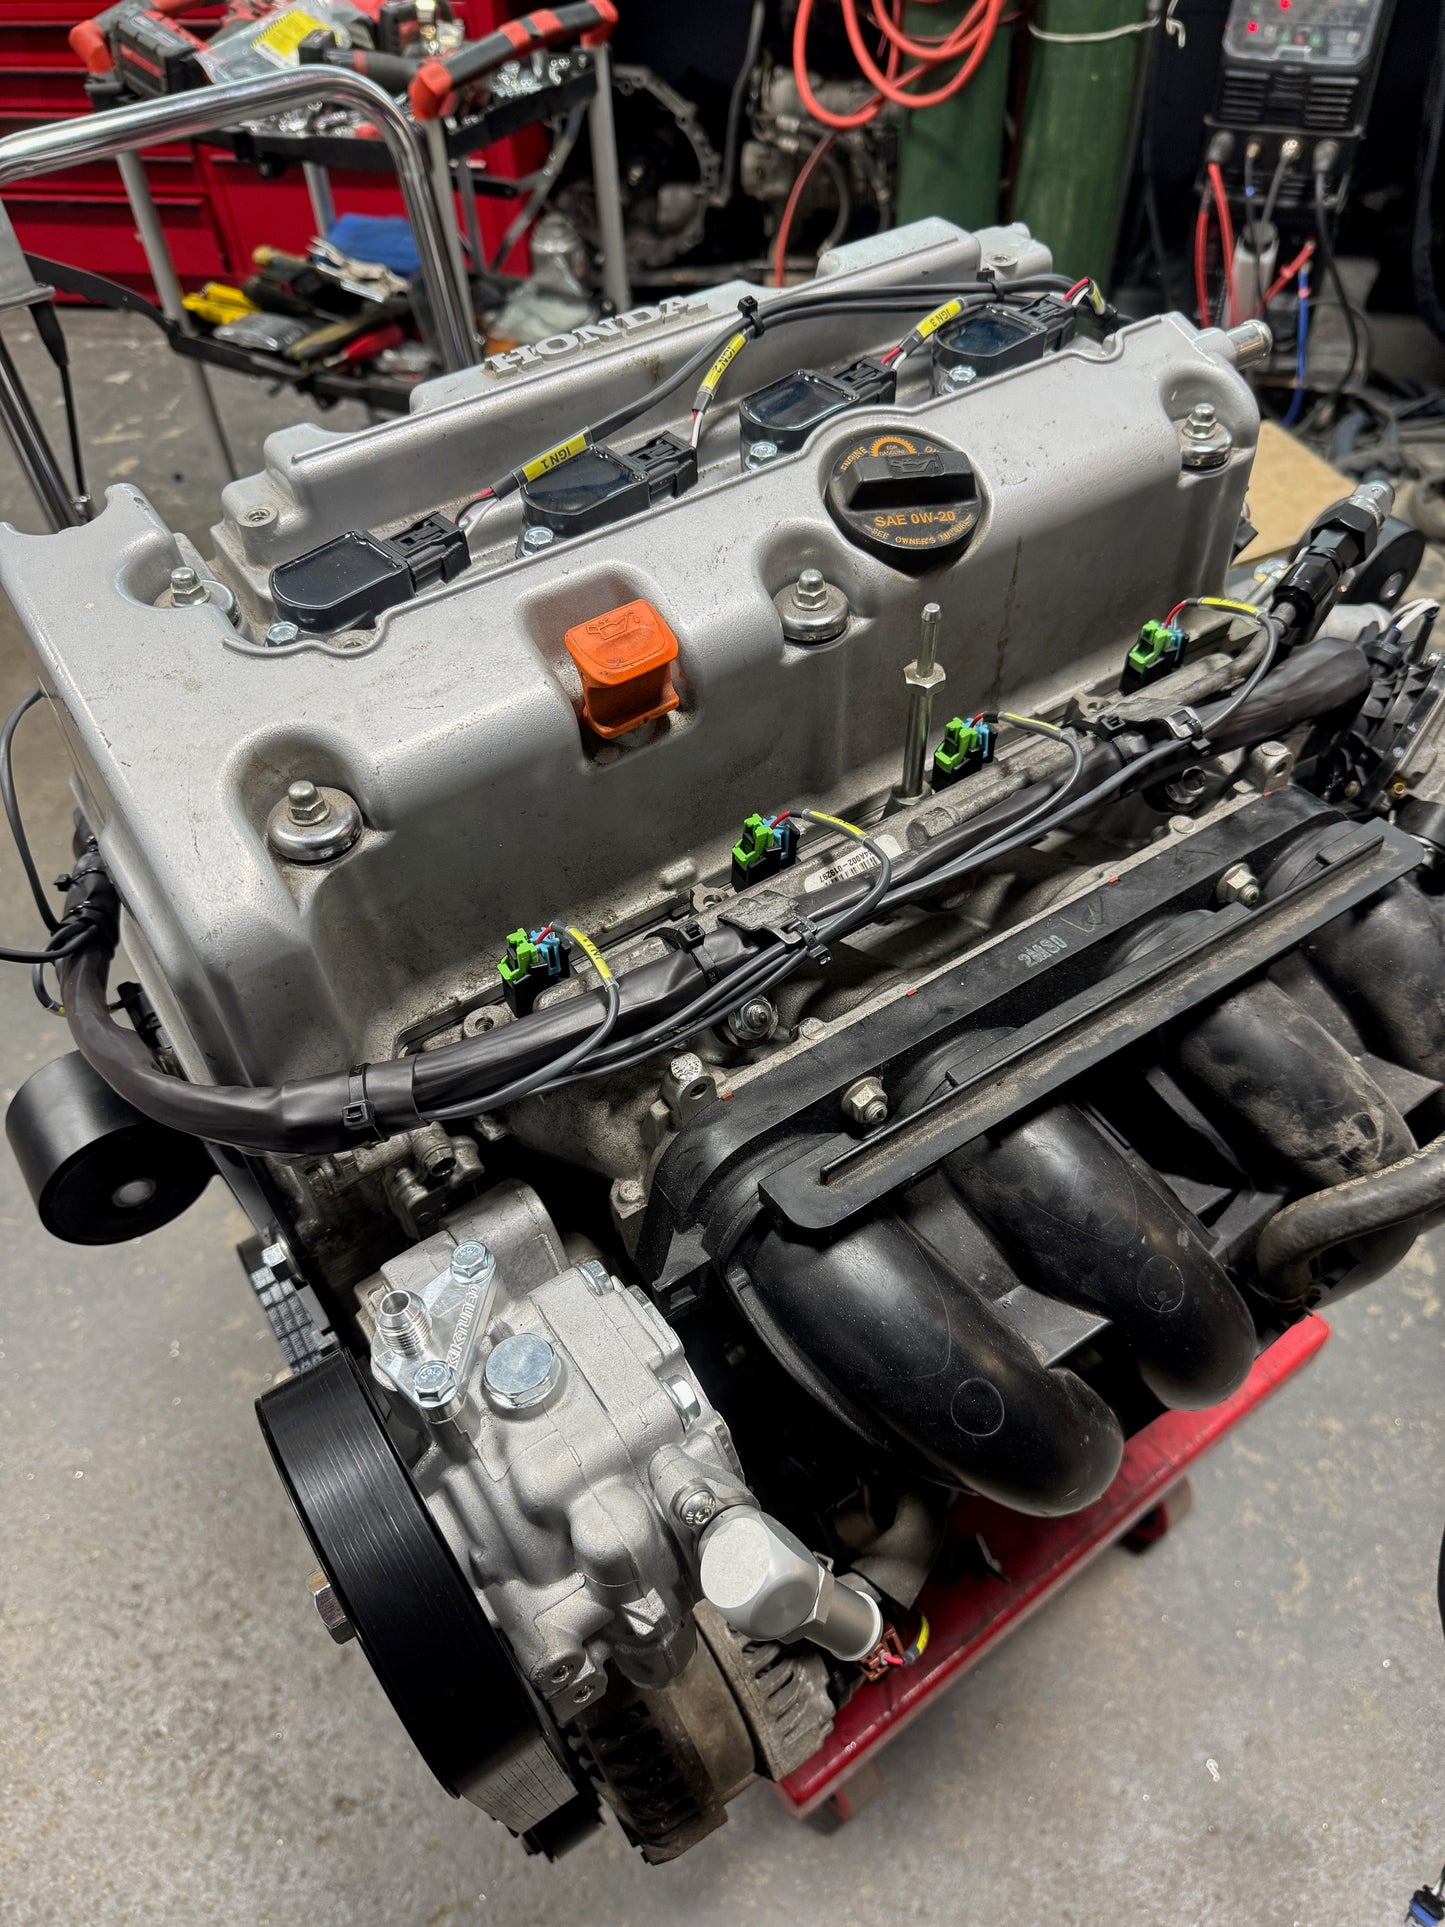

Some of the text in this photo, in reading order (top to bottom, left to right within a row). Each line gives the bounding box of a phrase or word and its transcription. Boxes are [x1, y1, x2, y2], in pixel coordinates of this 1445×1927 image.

[930, 308, 951, 328] IGN 3
[484, 296, 709, 378] HONDA
[719, 346, 736, 367] IGN
[540, 446, 571, 470] IGN 1
[841, 446, 868, 472] ENGINE
[874, 511, 956, 527] SAE 0W-20
[895, 535, 936, 546] OWNER'S
[819, 850, 873, 883] 4A002-019297
